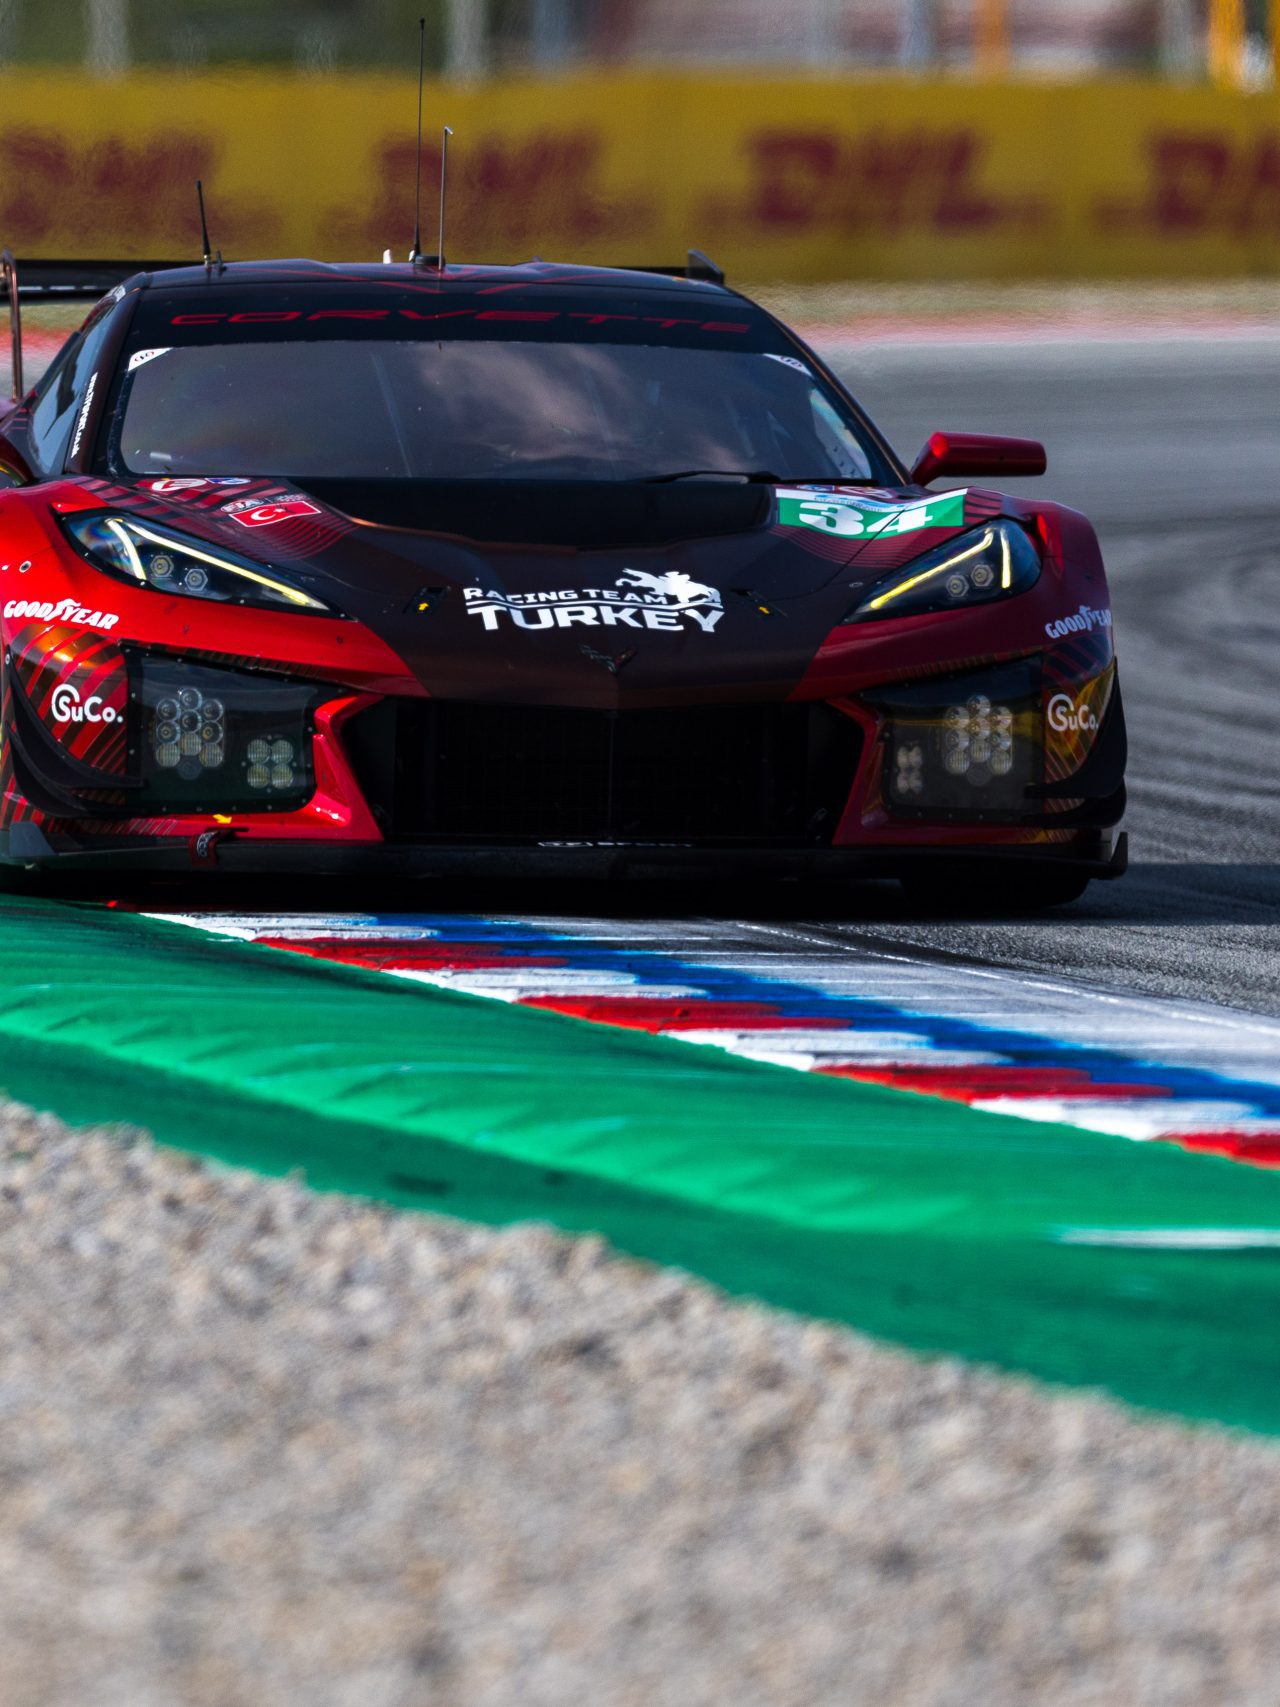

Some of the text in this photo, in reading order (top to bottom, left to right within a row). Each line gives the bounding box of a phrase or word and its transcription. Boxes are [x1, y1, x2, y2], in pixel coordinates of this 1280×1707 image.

[170, 308, 750, 334] CORVETTE
[799, 502, 933, 536] 34
[463, 587, 668, 605] RACING TEAM
[3, 598, 120, 631] GOODYEAR
[467, 605, 725, 633] TURKEY
